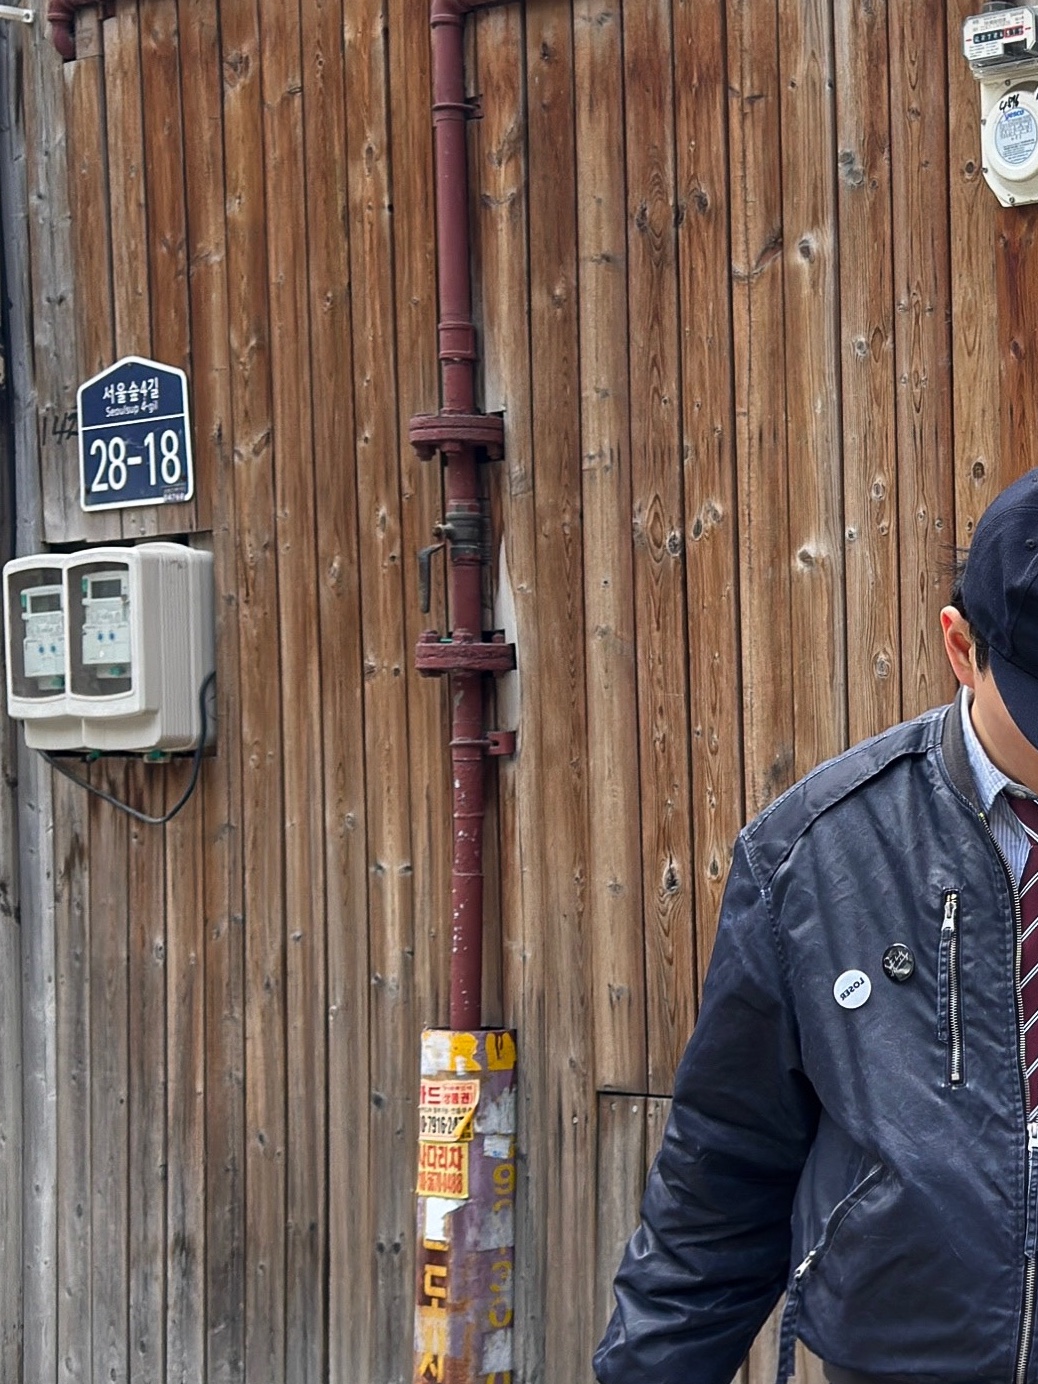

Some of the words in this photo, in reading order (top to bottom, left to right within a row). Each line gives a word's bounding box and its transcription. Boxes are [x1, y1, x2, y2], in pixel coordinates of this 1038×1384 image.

[102, 377, 160, 405] 서울숲4길
[105, 405, 140, 418] Seoulsup
[90, 429, 181, 493] 28-18
